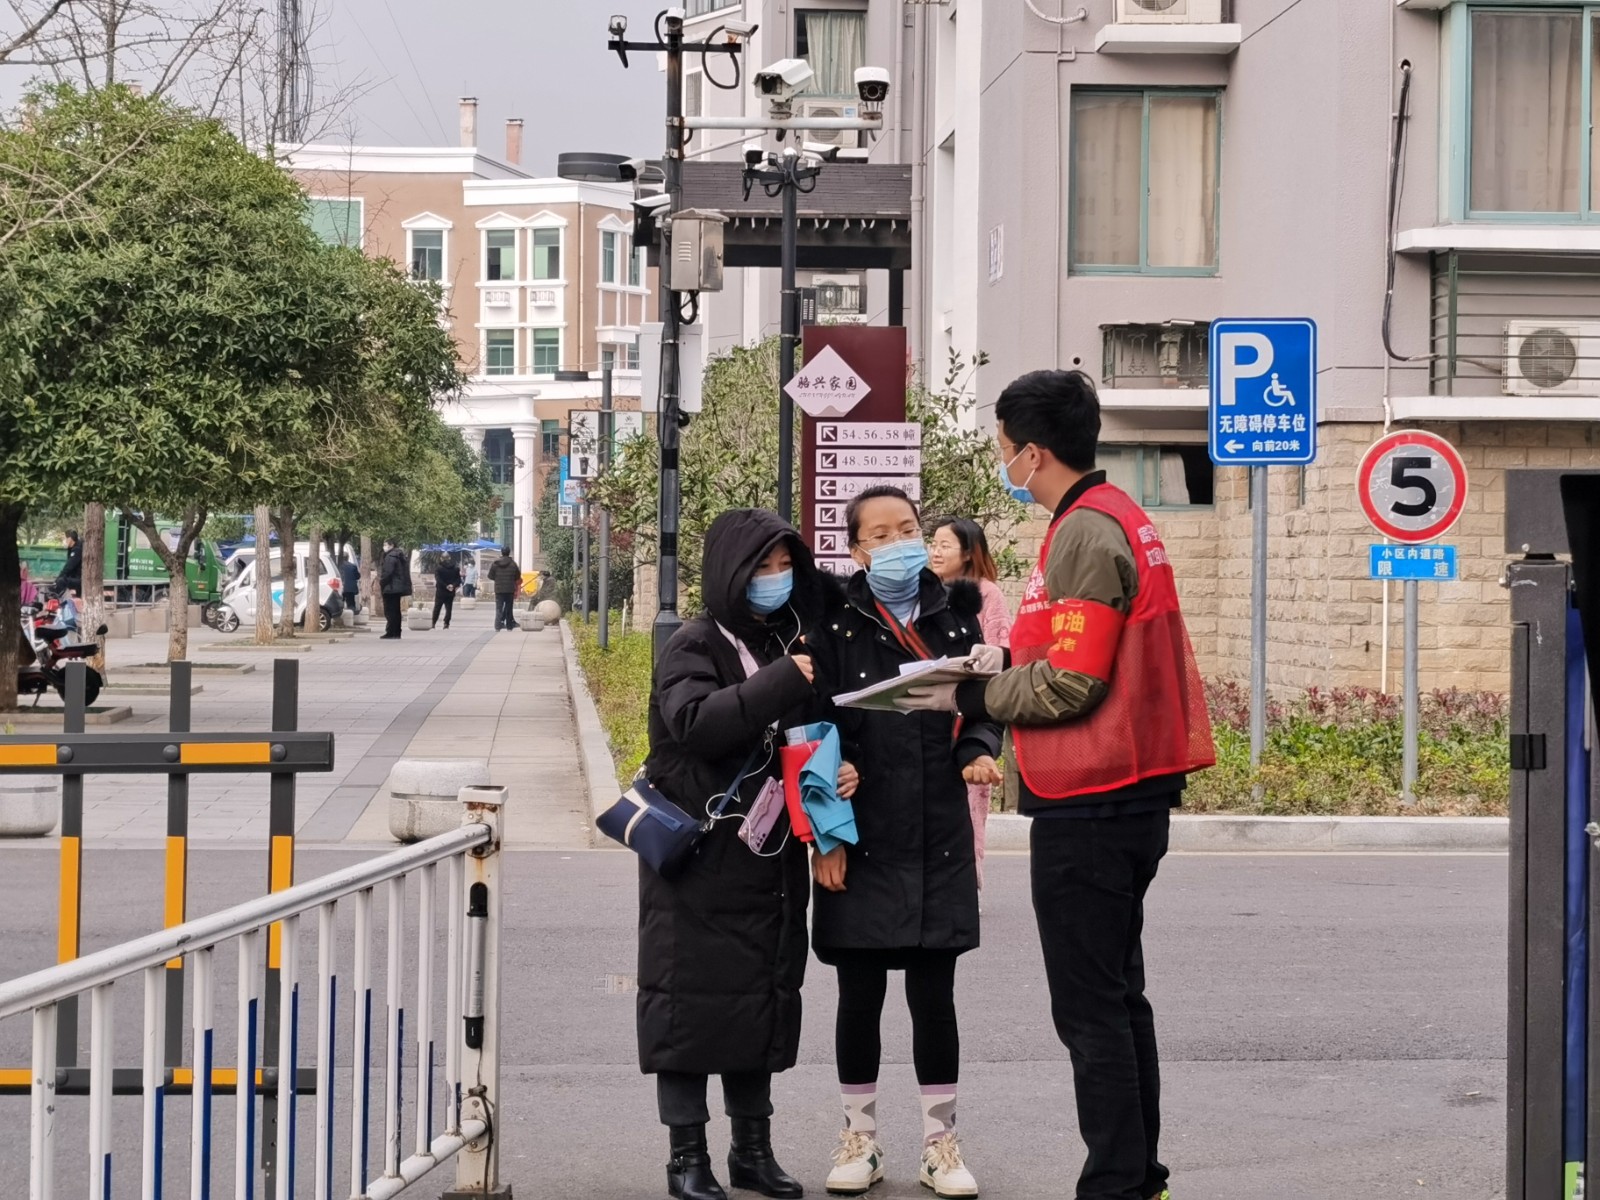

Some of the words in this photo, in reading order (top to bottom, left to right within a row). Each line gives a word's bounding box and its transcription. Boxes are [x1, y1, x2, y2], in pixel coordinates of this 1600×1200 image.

[1220, 332, 1274, 406] P
[1219, 414, 1306, 433] 无障碍停车位
[1252, 440, 1300, 452] 向前20米
[1390, 457, 1437, 516] 5
[1381, 548, 1444, 560] 小区内道路
